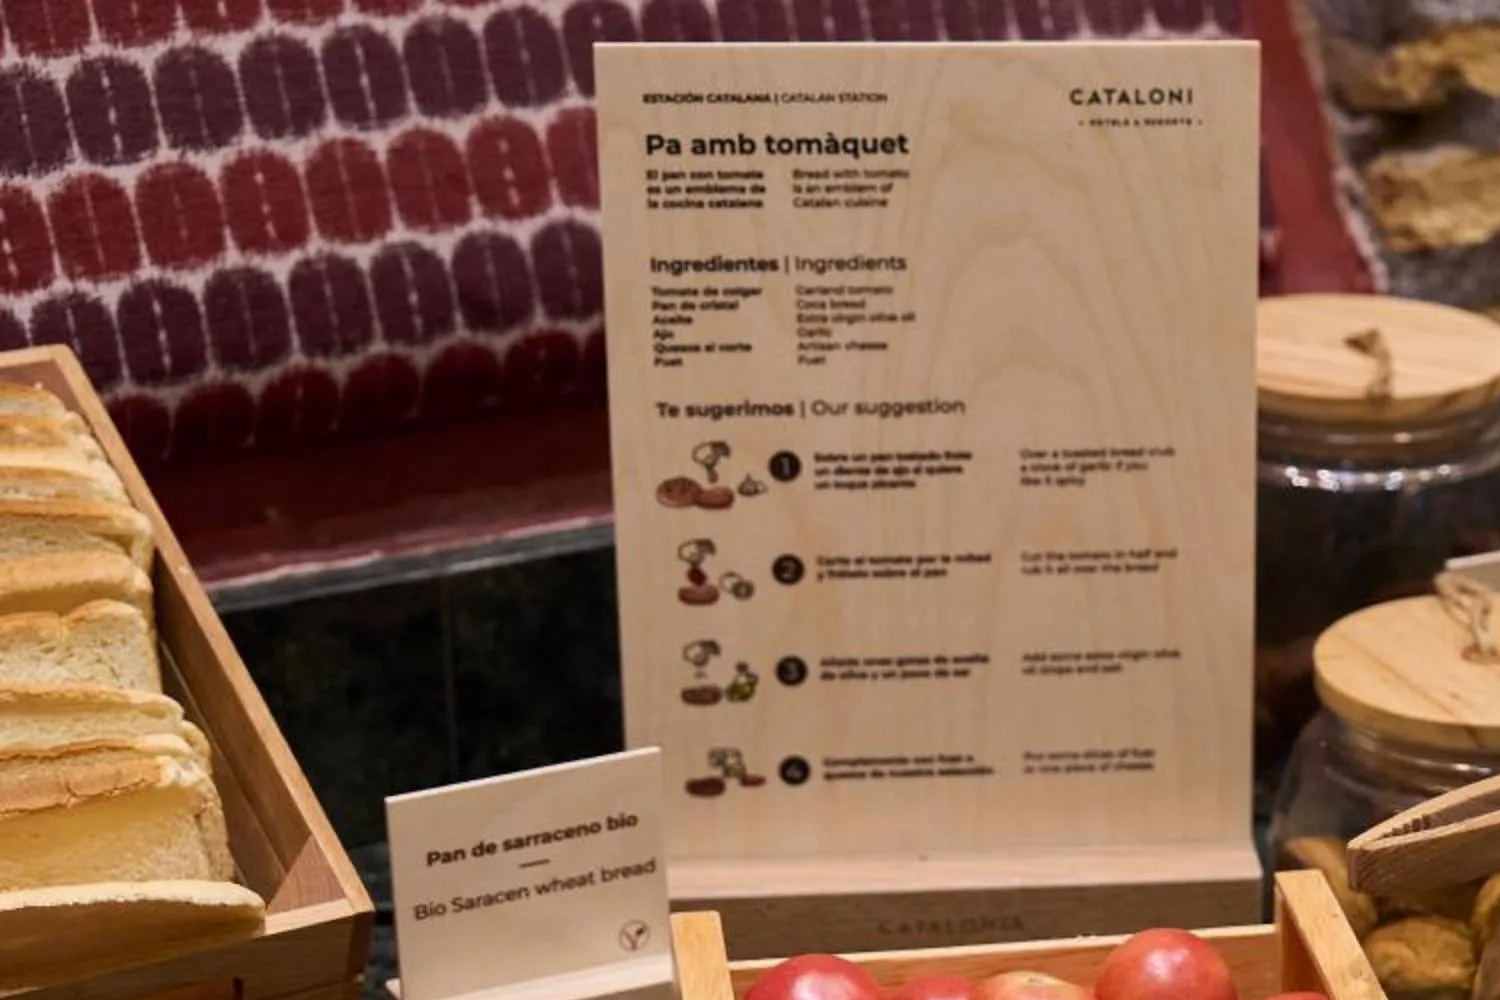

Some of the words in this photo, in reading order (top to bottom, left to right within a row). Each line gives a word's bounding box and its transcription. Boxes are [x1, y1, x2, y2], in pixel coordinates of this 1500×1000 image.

[642, 93, 703, 104] ESTACIÓN
[707, 94, 771, 104] CATALANA
[781, 93, 835, 103] CATALAN
[838, 92, 888, 103] STATION
[645, 134, 682, 155] Pa
[690, 133, 757, 155] amb
[764, 132, 910, 159] tomàquet
[645, 169, 658, 180] El
[662, 170, 687, 181] pan
[717, 170, 764, 180] tomate
[650, 256, 779, 275] Ingredientes
[795, 255, 907, 275] Ingredients
[656, 402, 680, 419] Te
[686, 401, 795, 422] sugerimos
[811, 399, 850, 417] Our
[854, 397, 966, 420] suggestion
[426, 849, 467, 867] Pan
[472, 839, 497, 859] de
[502, 822, 603, 852] sarraceno
[605, 812, 639, 831] bio
[414, 902, 447, 920] Bio
[451, 886, 529, 914] Saracen
[534, 871, 596, 898] wheat
[600, 857, 657, 883] bread
